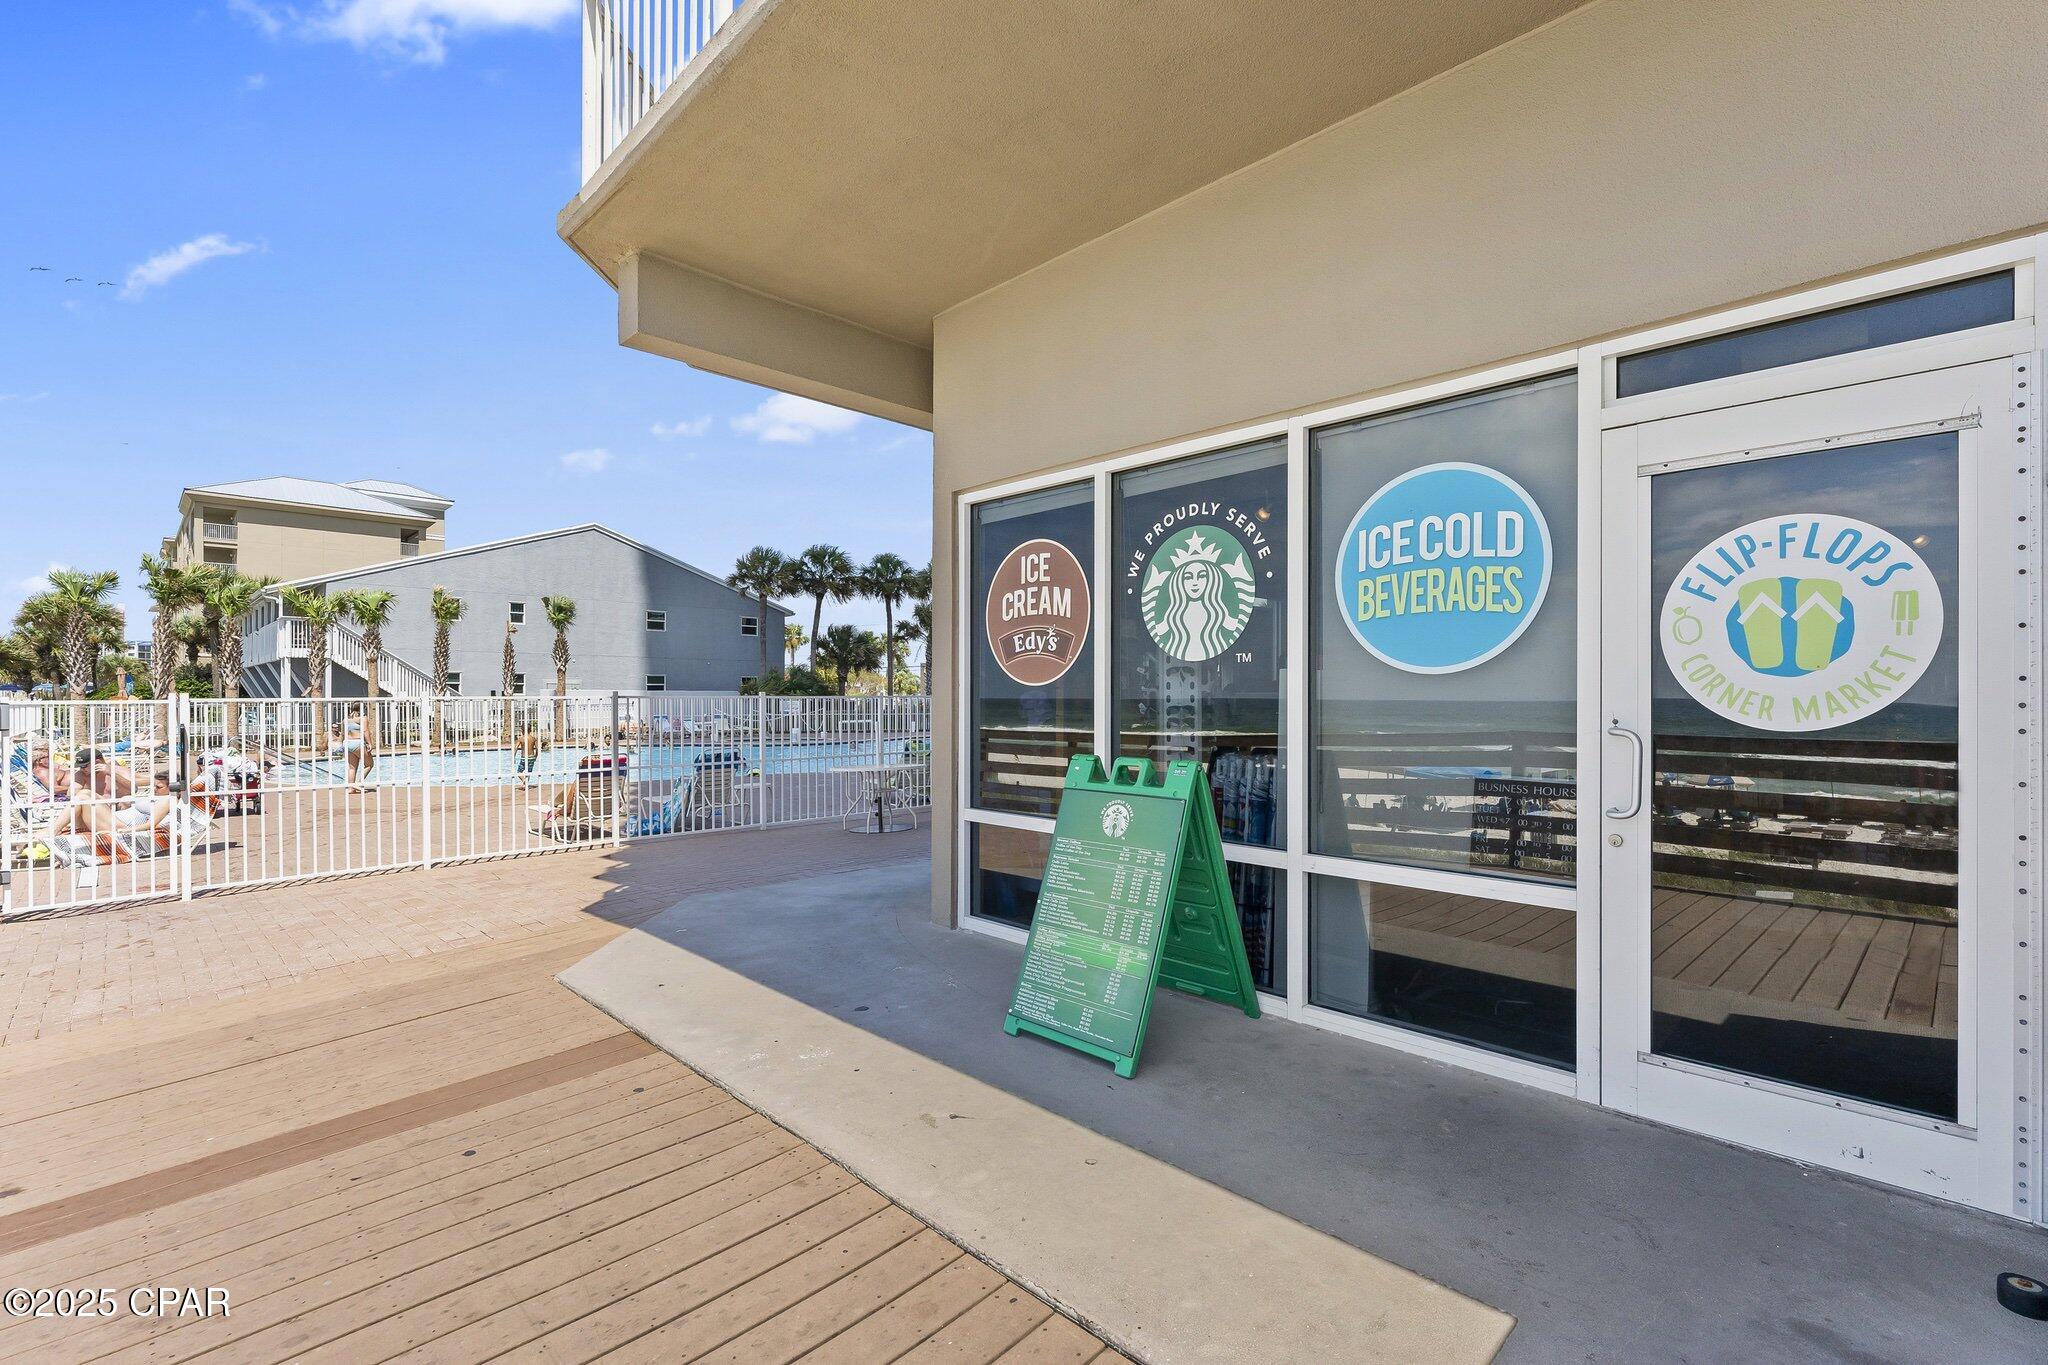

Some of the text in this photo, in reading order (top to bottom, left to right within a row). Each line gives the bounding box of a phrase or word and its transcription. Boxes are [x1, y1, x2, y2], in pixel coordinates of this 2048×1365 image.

[1127, 502, 1272, 578] WE PROUDLY SERVE
[1358, 510, 1524, 573] ICE COLD
[1680, 522, 1914, 602] FLIP-FLOPS
[1020, 552, 1051, 585] ICE
[1001, 587, 1072, 623] CREAM
[1357, 565, 1524, 622] BEVERAGES
[1012, 630, 1058, 655] Edy's
[1235, 652, 1252, 663] TM
[1681, 644, 1917, 723] CORNER MARKET
[1478, 782, 1576, 797] BUSINESS HOURS
